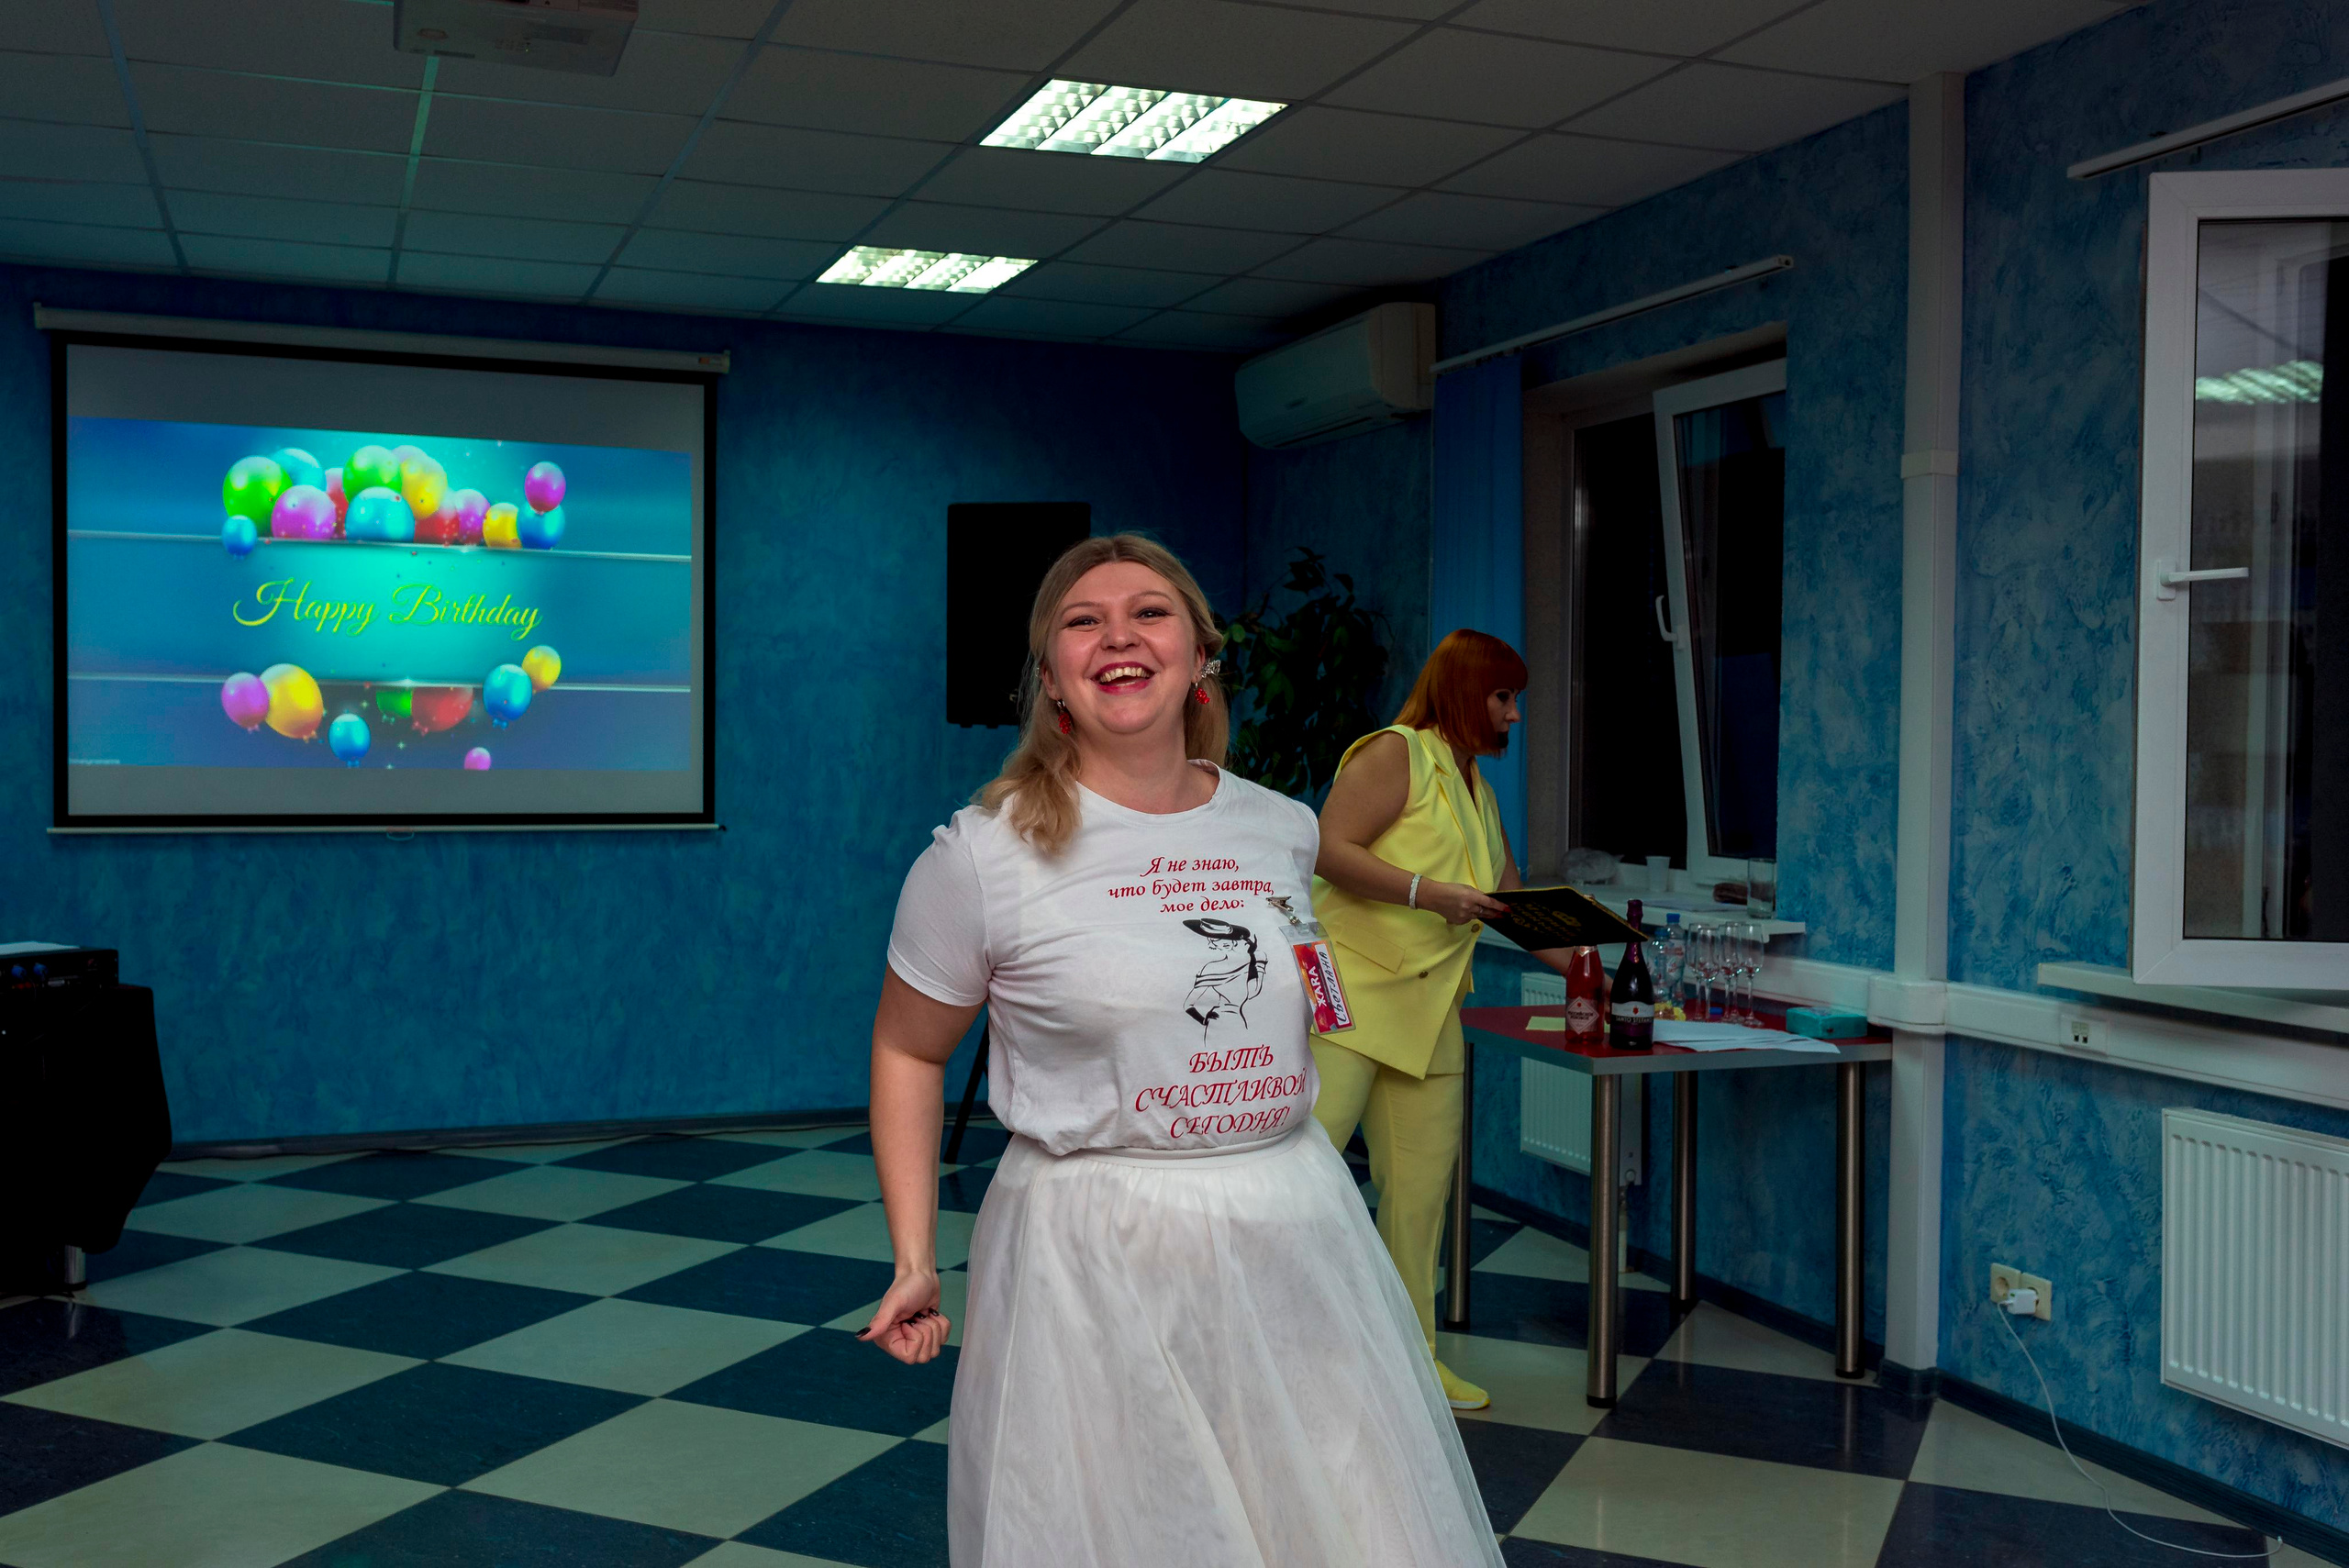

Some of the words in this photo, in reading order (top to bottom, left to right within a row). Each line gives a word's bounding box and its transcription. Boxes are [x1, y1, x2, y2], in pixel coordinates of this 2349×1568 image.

[233, 577, 377, 637] Happy
[389, 583, 542, 641] Birthday
[1140, 856, 1165, 877] Я
[1167, 860, 1187, 873] не
[1192, 858, 1240, 873] знаю,
[1108, 885, 1146, 899] что
[1152, 878, 1207, 900] будет
[1211, 880, 1275, 896] завтра,
[1160, 902, 1194, 913] мое
[1200, 895, 1245, 912] дело:
[1189, 1044, 1274, 1073] БЫТЬ
[1135, 1067, 1308, 1112] СЧАСТЛИВОЙ
[1170, 1106, 1291, 1139] СЕГОДНЯ!
